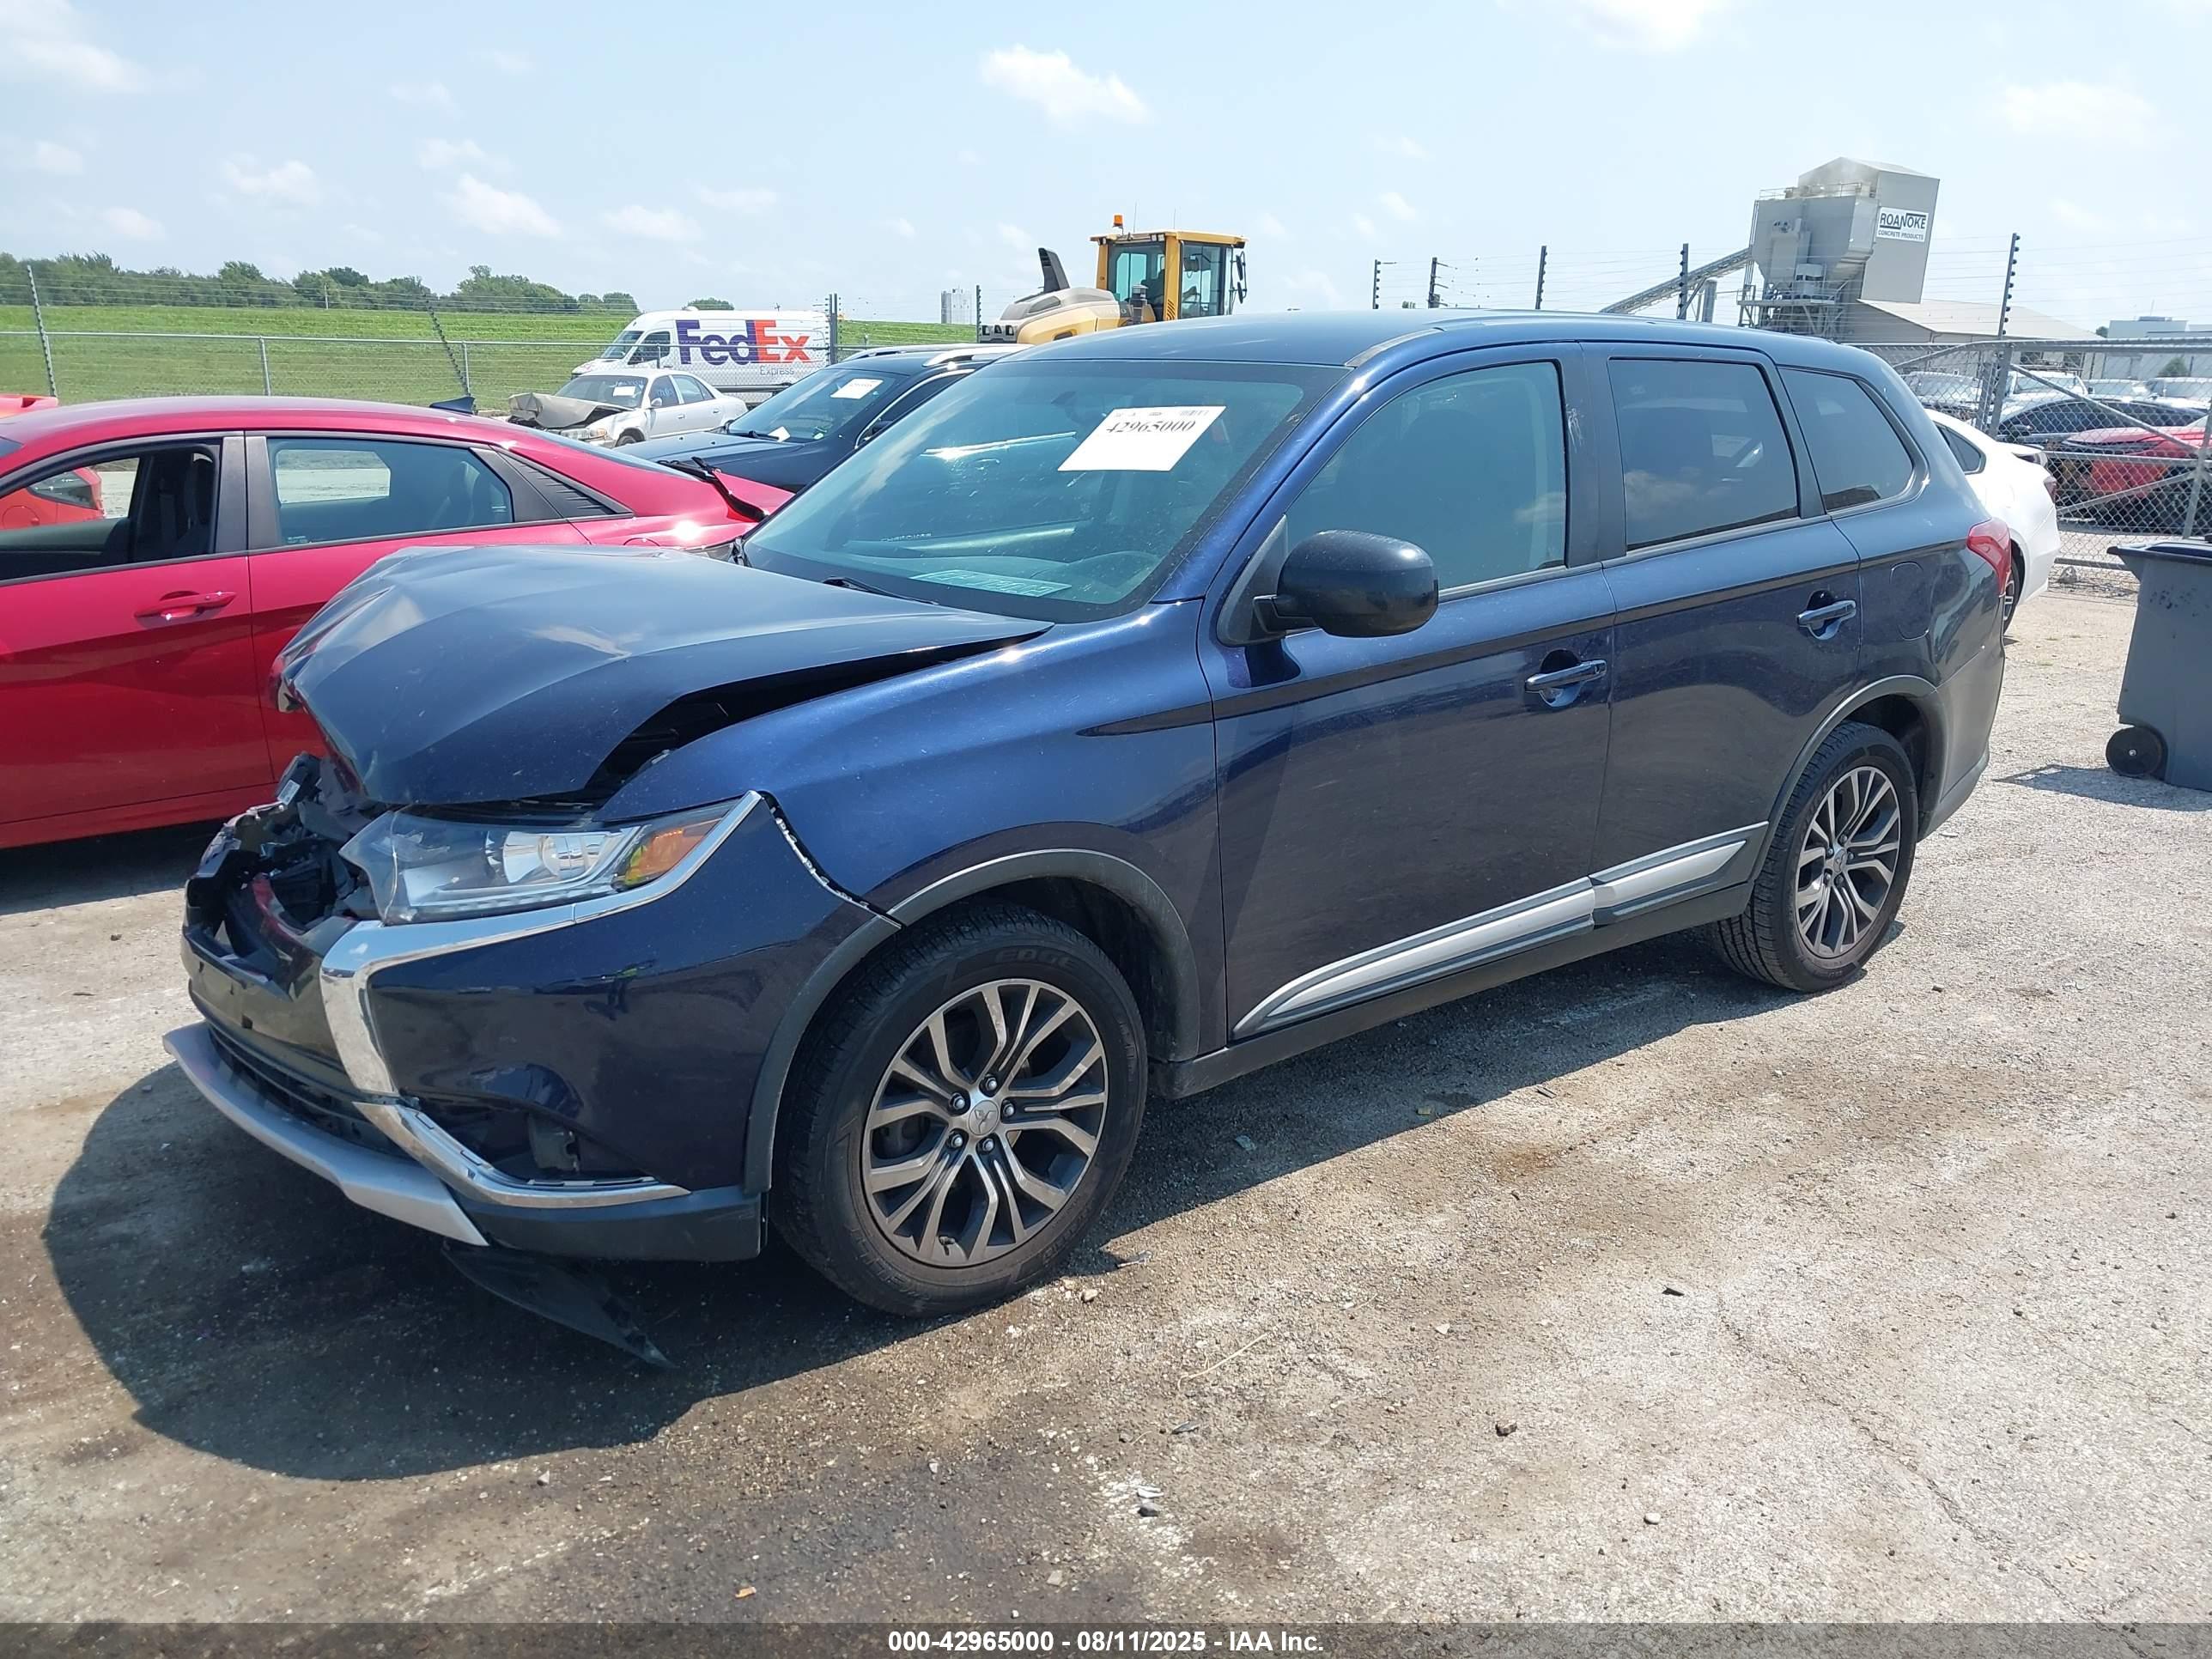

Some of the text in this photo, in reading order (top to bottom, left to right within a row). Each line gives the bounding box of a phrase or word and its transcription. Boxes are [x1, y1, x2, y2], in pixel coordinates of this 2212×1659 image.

[1880, 214, 1927, 229] ROANOKE
[676, 319, 811, 366] FedEx
[760, 365, 794, 376] Express
[1106, 420, 1196, 433] 42965000
